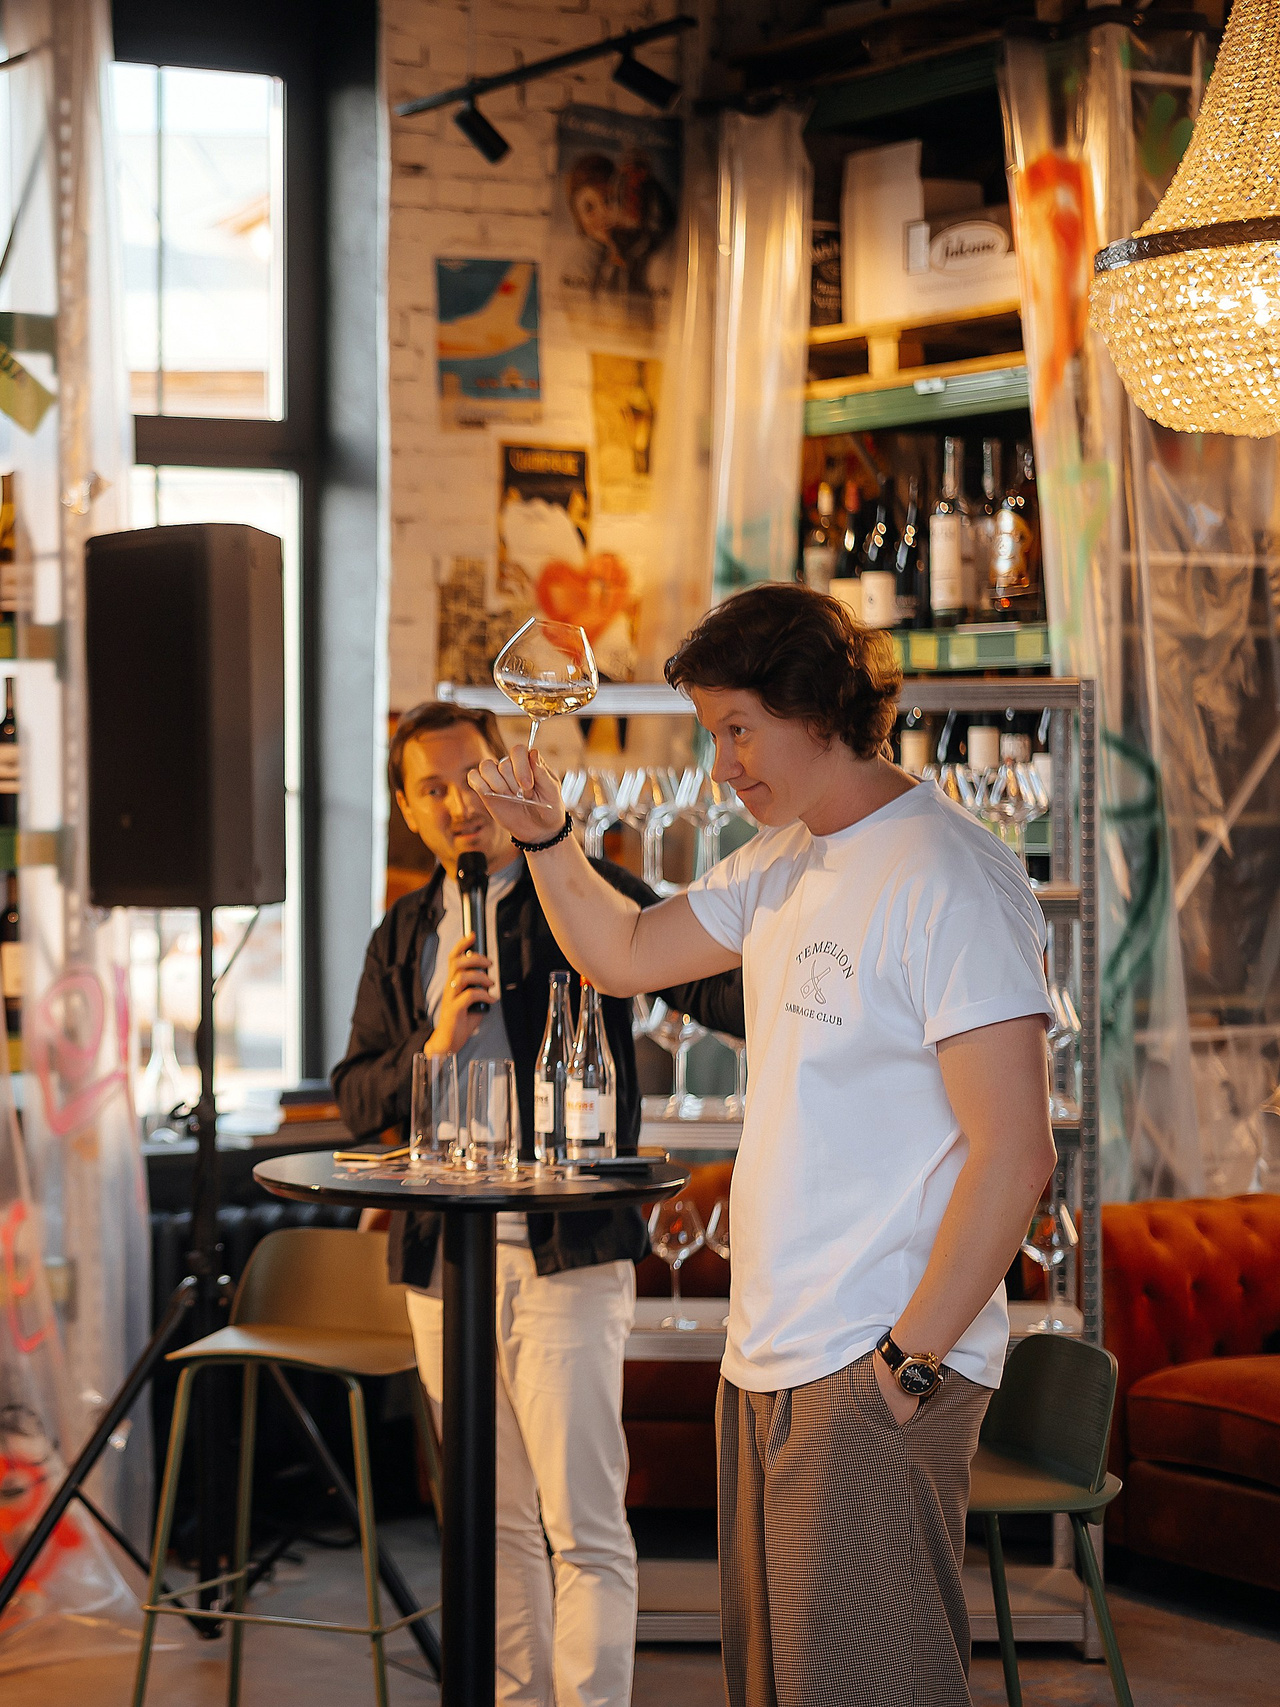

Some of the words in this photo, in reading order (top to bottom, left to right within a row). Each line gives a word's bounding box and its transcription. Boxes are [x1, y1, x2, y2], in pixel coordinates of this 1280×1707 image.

[795, 940, 854, 980] TEMELION
[784, 1002, 815, 1019] SABRAGE
[816, 1012, 843, 1026] CLUB
